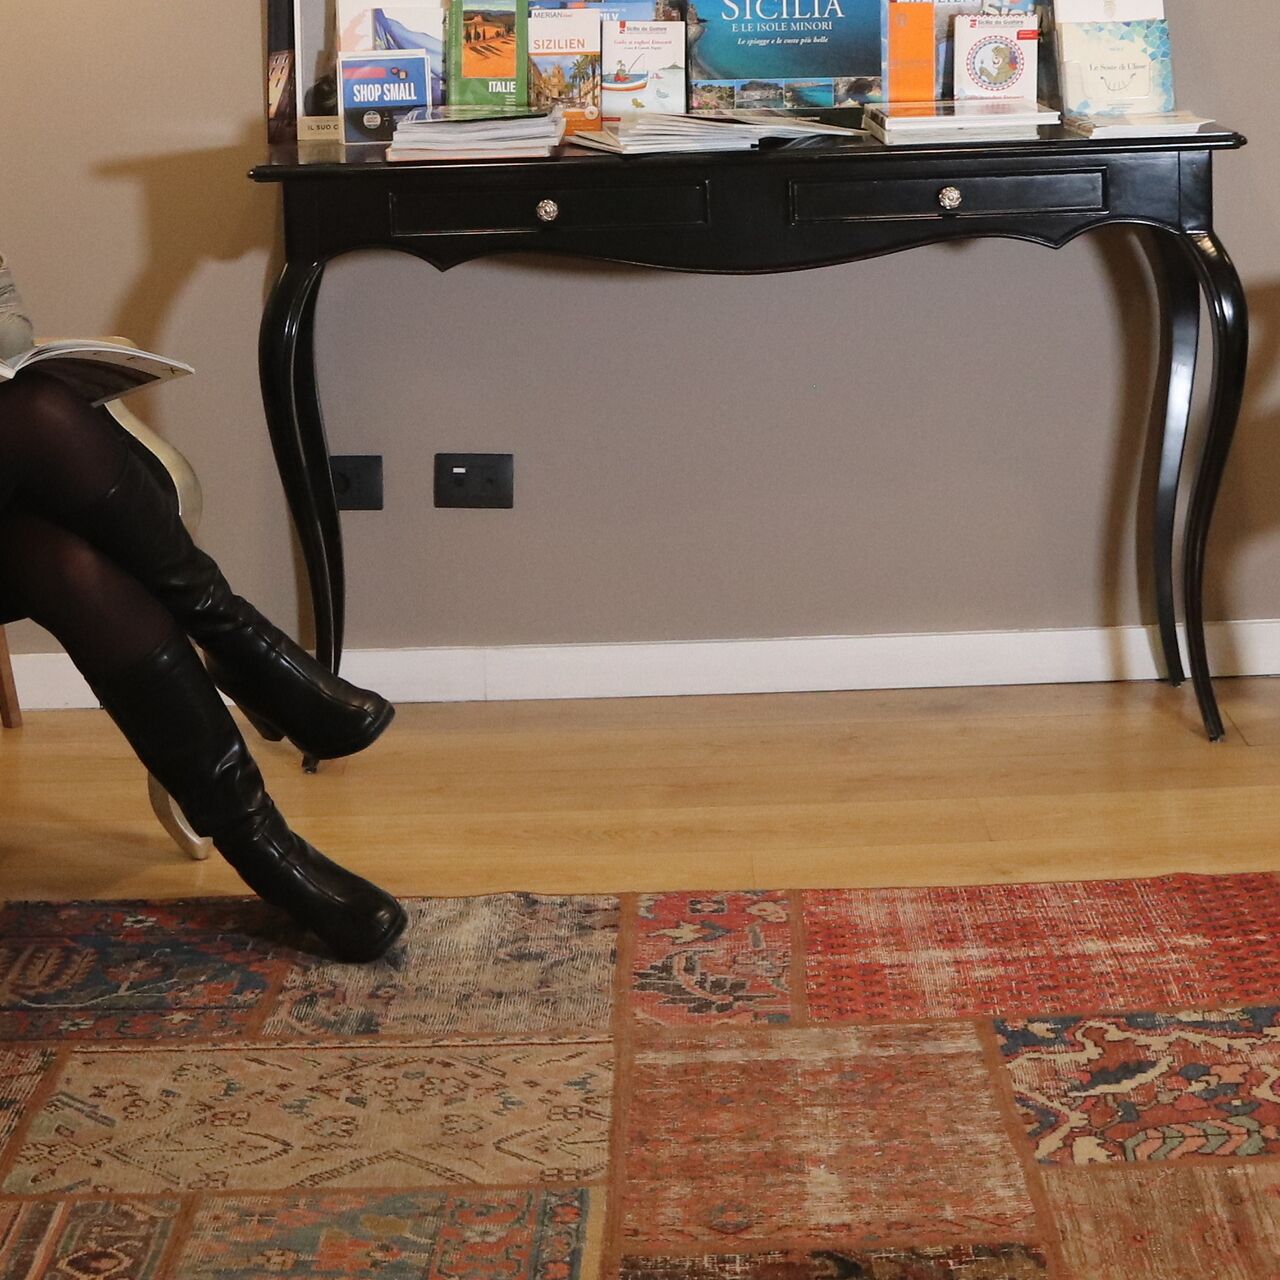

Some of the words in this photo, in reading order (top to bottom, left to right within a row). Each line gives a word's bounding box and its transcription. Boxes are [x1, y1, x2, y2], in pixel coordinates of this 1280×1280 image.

[732, 23, 738, 32] E
[741, 23, 754, 32] LE
[757, 22, 788, 32] ISOLE
[790, 21, 833, 31] MINORI
[533, 39, 585, 49] SIZILIEN
[353, 84, 381, 102] SHOP
[383, 82, 418, 100] SMALL
[489, 81, 516, 92] ITALIE
